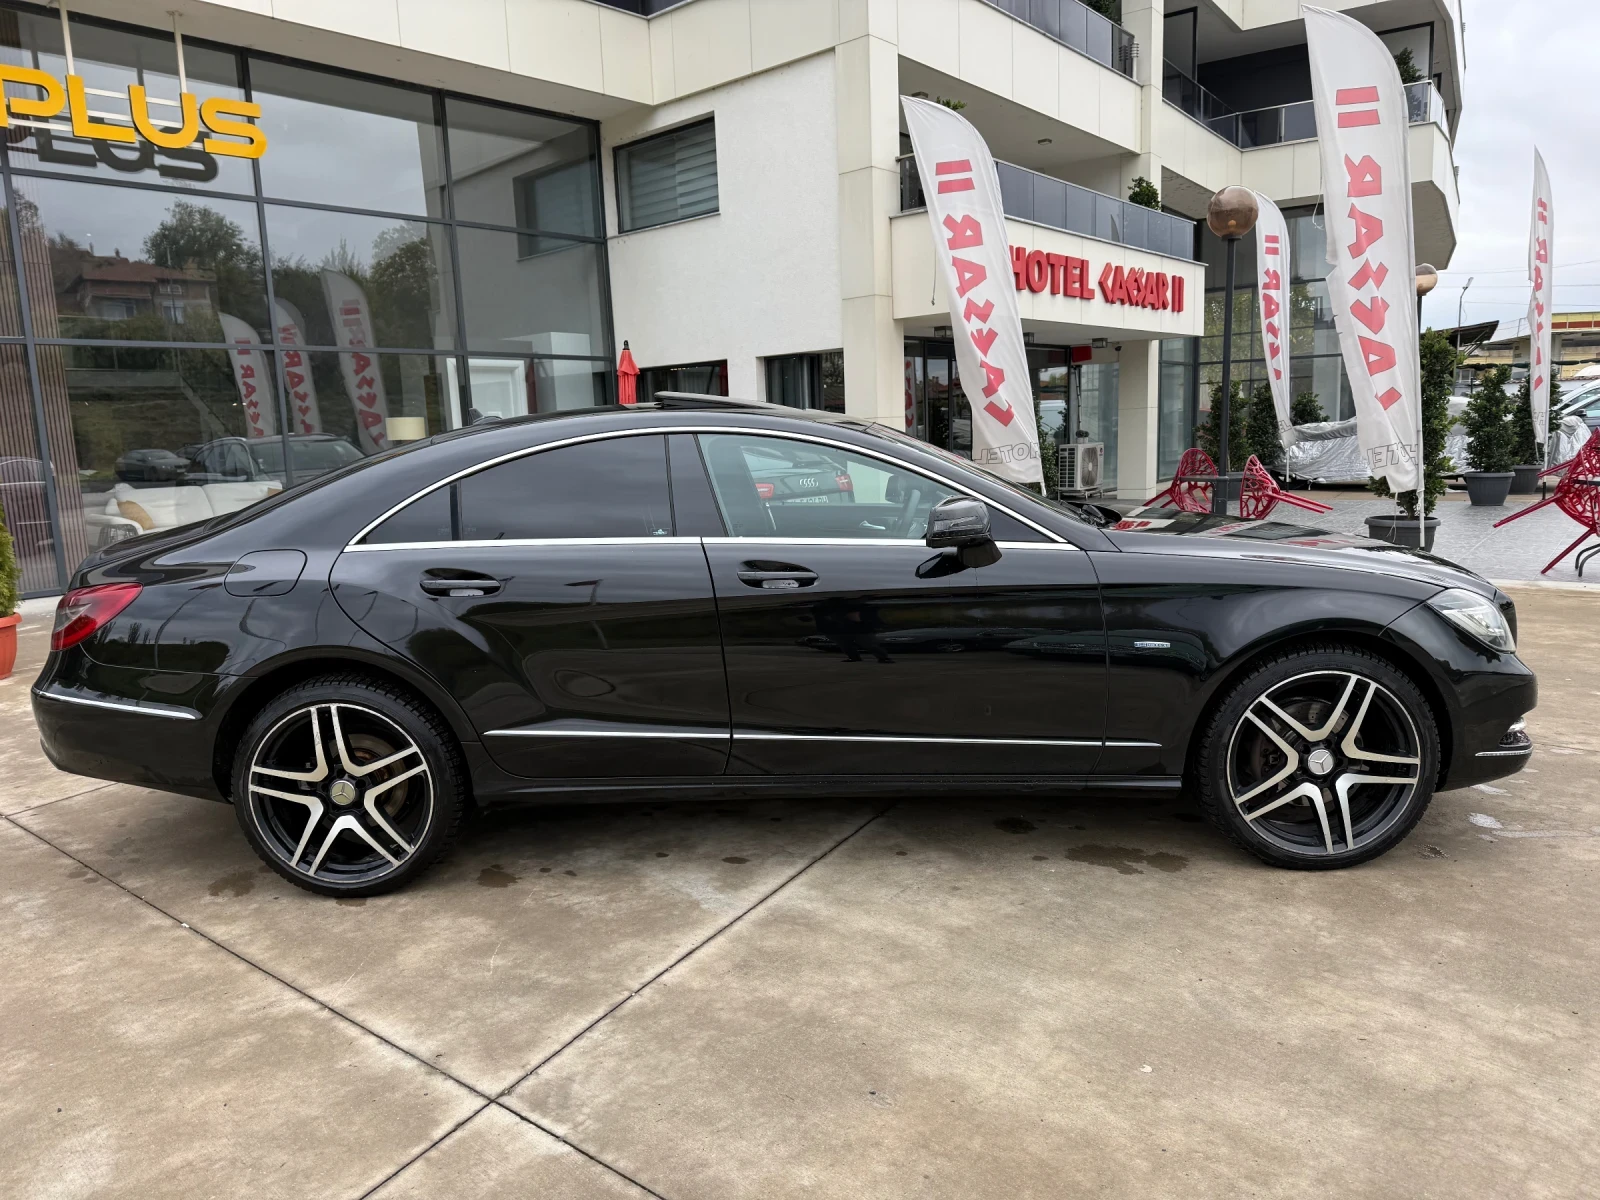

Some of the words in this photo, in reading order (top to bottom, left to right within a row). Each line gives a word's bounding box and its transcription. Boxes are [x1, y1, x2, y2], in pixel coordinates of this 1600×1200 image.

[0, 63, 267, 158] PLUS
[1009, 244, 1095, 300] HOTEL
[1098, 262, 1170, 311] CAESAR
